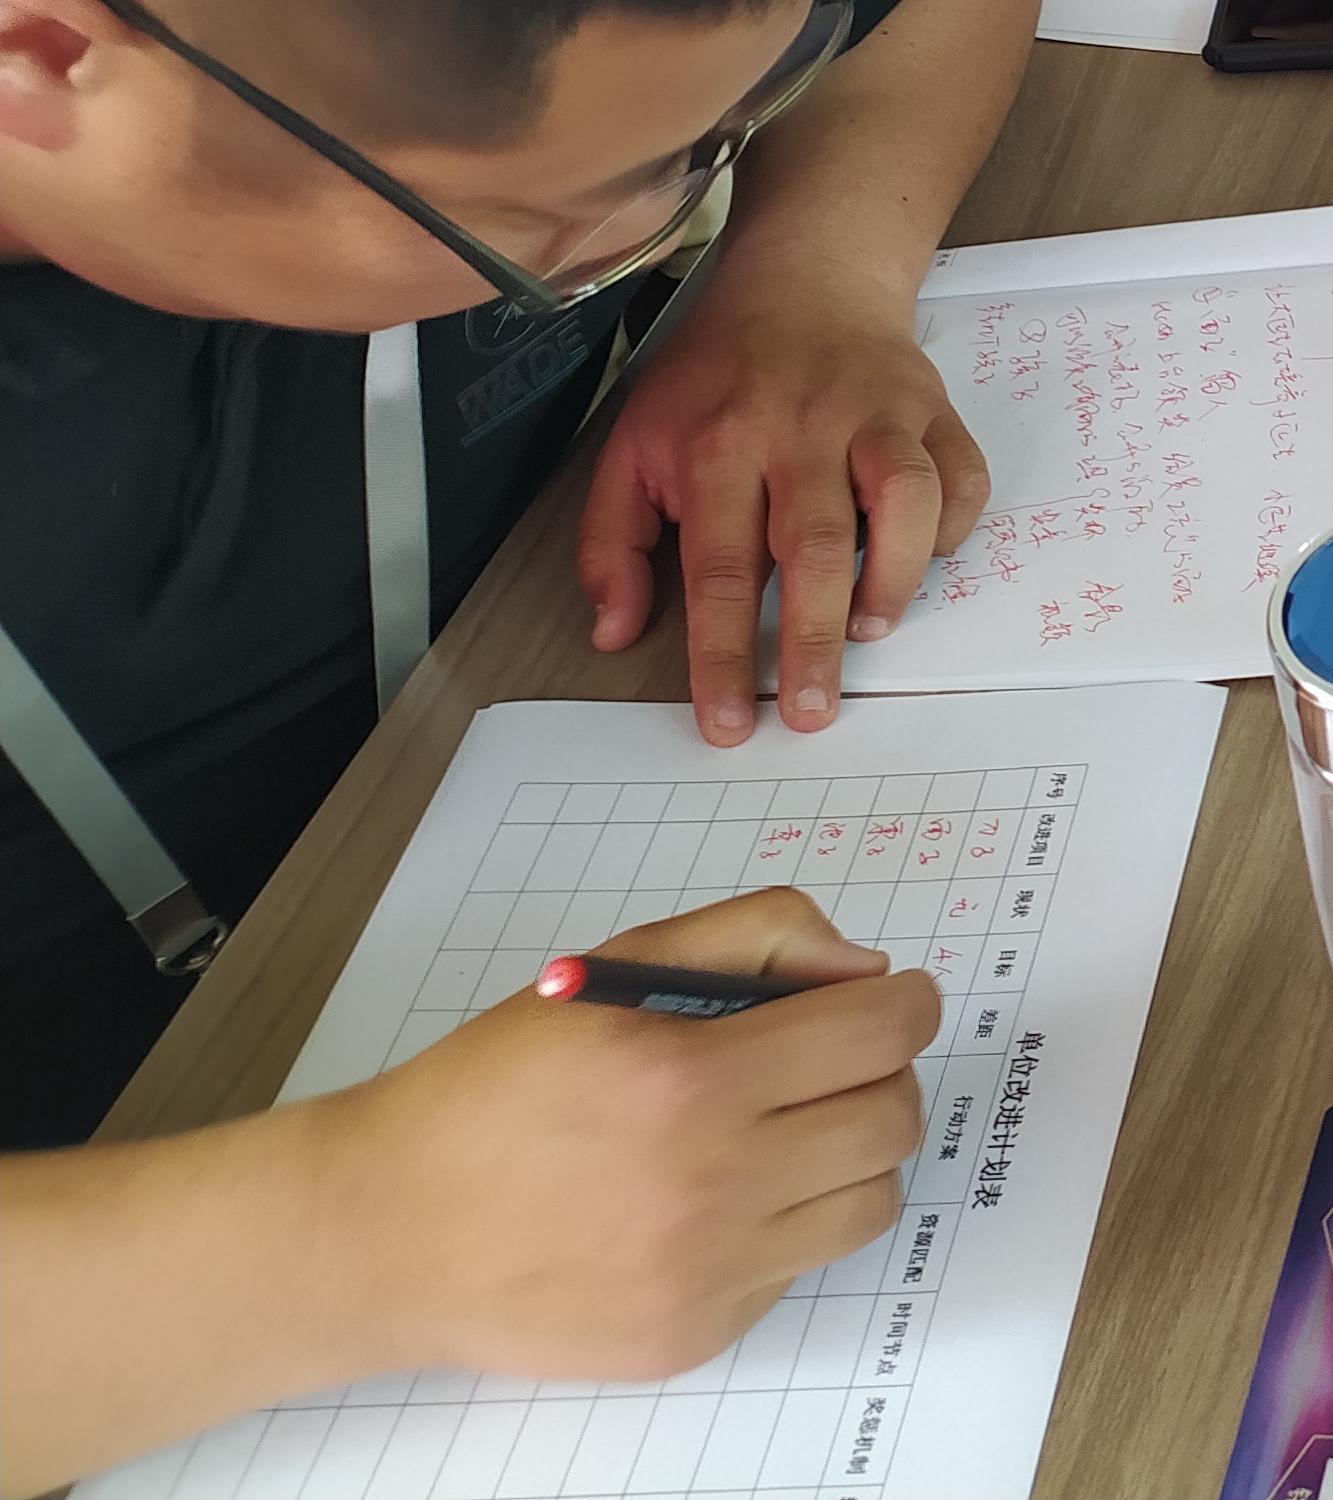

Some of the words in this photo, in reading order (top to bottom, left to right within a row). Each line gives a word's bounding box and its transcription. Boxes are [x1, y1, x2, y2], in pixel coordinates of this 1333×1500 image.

[1050, 771, 1069, 802] 序号
[1031, 812, 1059, 869] 改进项目
[1014, 887, 1037, 919] 现状
[998, 949, 1019, 979] 目标
[973, 1008, 999, 1040] 差距
[937, 1093, 970, 1161] 行动方案
[971, 1029, 1048, 1211] 单位改进计划表
[900, 1213, 942, 1286] 资源匹配
[874, 1301, 914, 1378] 时间节点
[844, 1395, 889, 1477] 奖惩机制
